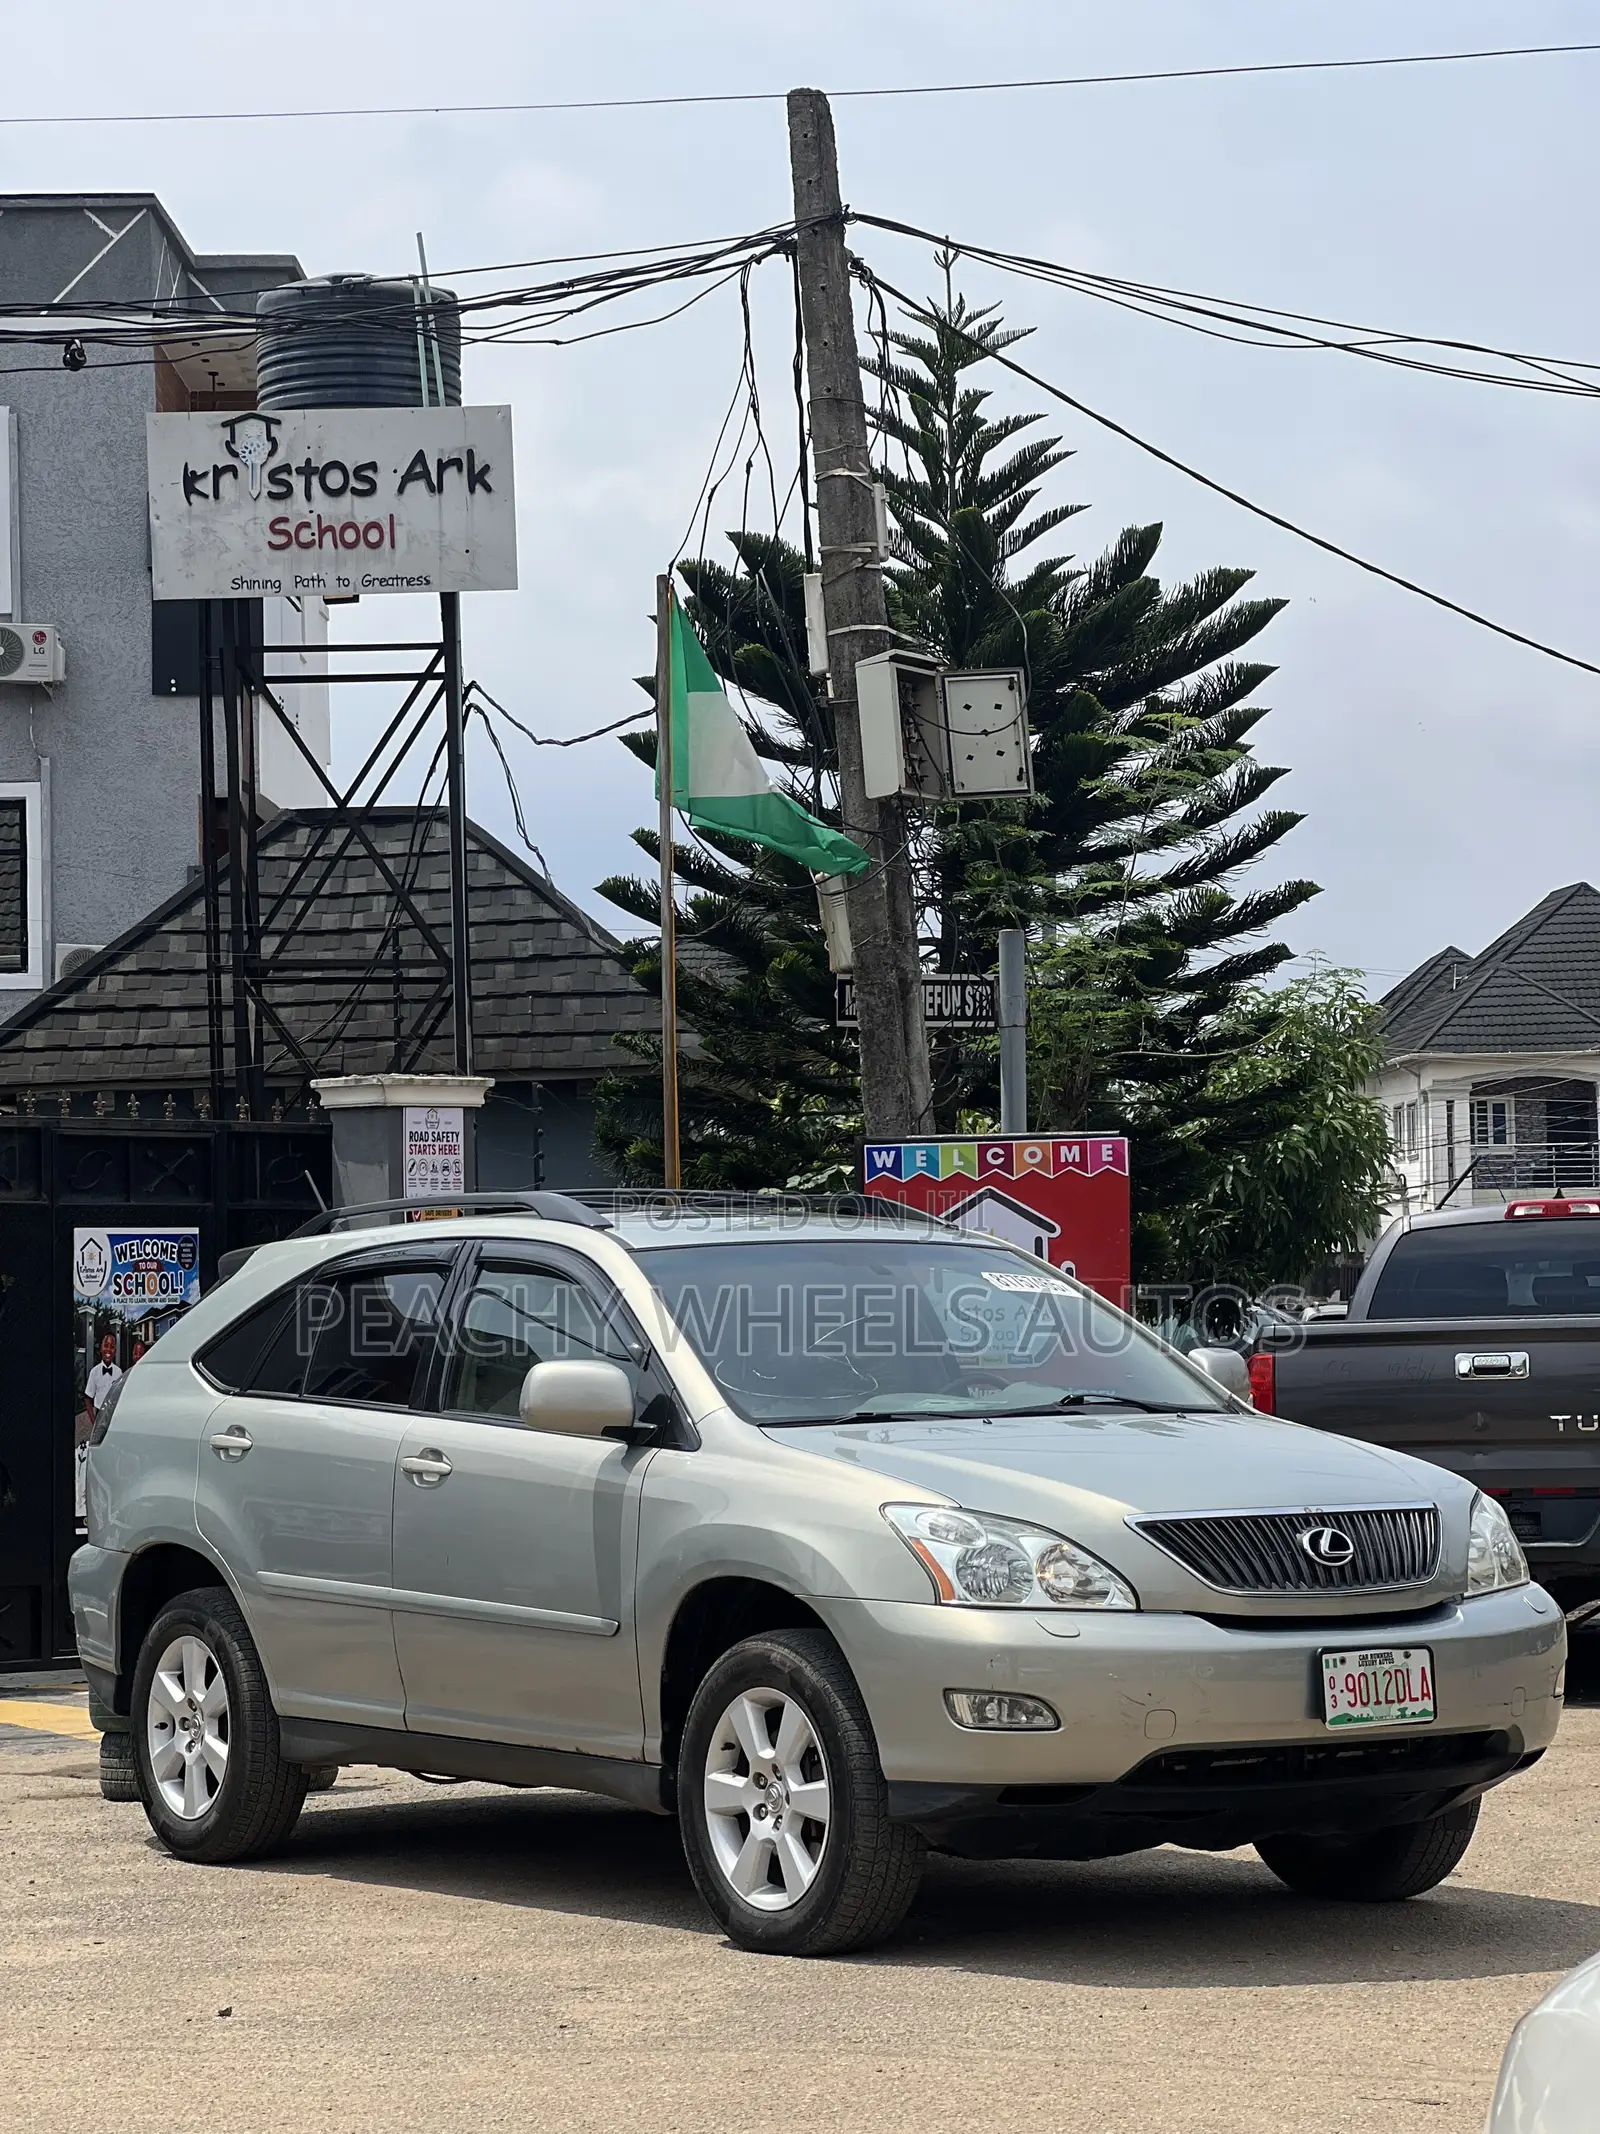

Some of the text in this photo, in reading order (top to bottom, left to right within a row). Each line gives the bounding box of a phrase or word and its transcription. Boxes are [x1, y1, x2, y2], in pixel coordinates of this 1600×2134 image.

[399, 449, 493, 494] Ark
[267, 513, 396, 550] School
[231, 573, 431, 593] Shining Path to Greatness
[33, 647, 45, 655] LG
[921, 985, 961, 1016] EFUN
[409, 1131, 460, 1142] ROAD SAFETY
[409, 1144, 460, 1155] STARTS HERE!
[872, 1144, 1113, 1169] WELCOME
[114, 1239, 178, 1264] WELCOME
[138, 1262, 146, 1270] TO
[112, 1270, 185, 1296] SCHOOL!
[1344, 1666, 1432, 1708] 9012DLA
